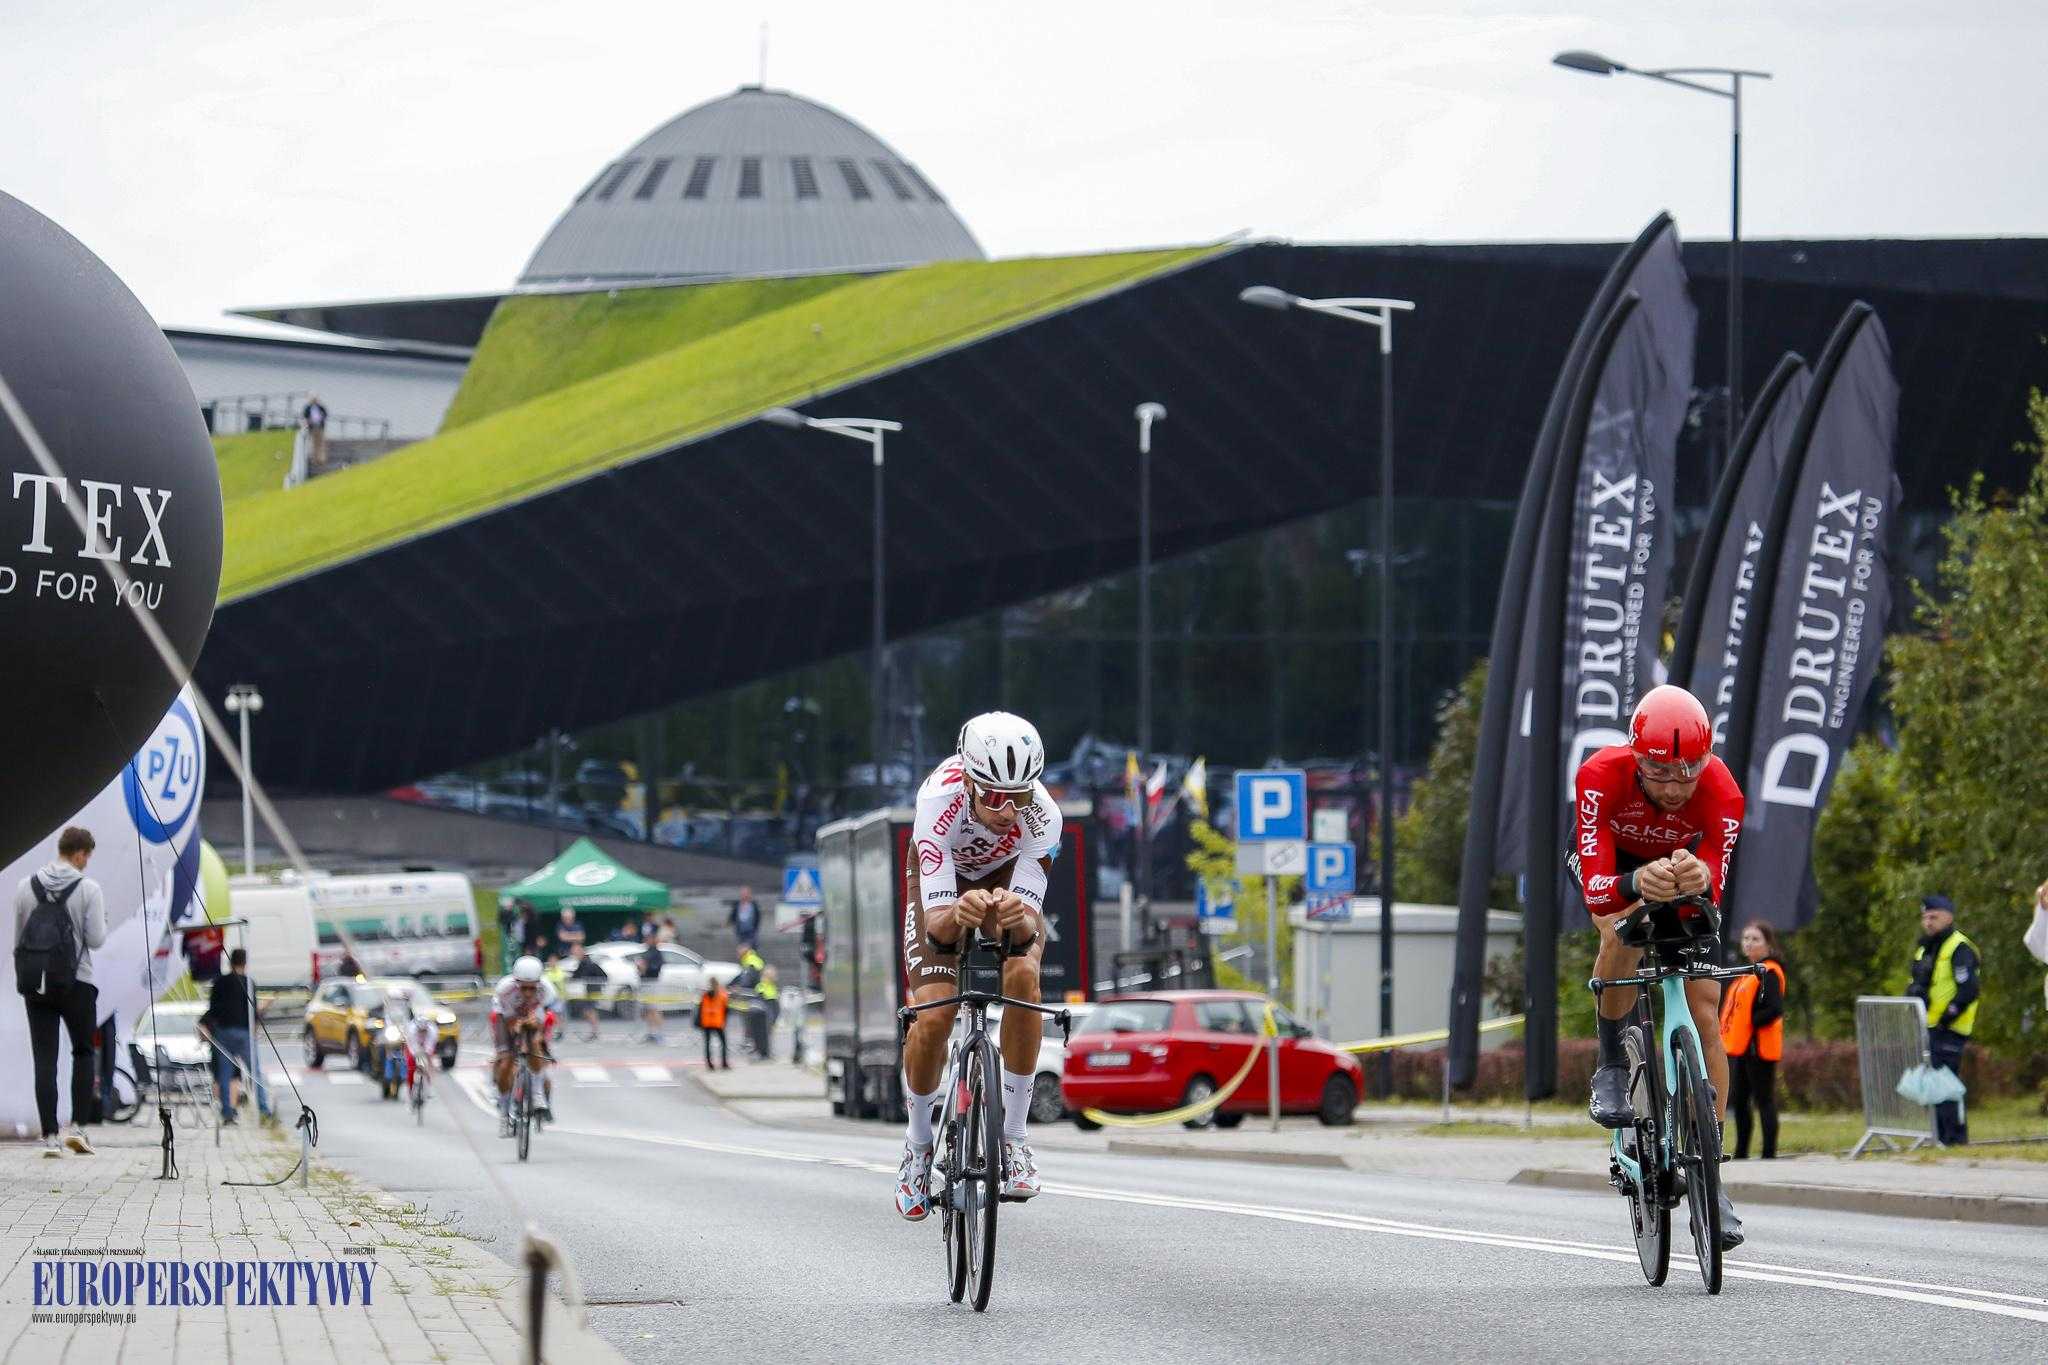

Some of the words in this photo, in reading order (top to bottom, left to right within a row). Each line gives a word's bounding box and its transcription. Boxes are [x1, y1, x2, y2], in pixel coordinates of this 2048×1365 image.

[1637, 478, 1656, 526] YOU
[1860, 496, 1882, 541] YOU
[1631, 532, 1653, 575] FOR
[1851, 548, 1875, 592] FOR
[36, 569, 98, 604] FOR
[113, 577, 164, 610] YOU
[1576, 469, 1638, 722] DRUTEX
[1781, 480, 1862, 729] DRUTEX
[1828, 597, 1866, 729] ENGINEERED
[146, 736, 193, 801] PZU
[1020, 807, 1046, 839] ONDIALE
[1252, 777, 1293, 835] P
[1581, 789, 1604, 857] ARKEA
[1315, 848, 1347, 887] P
